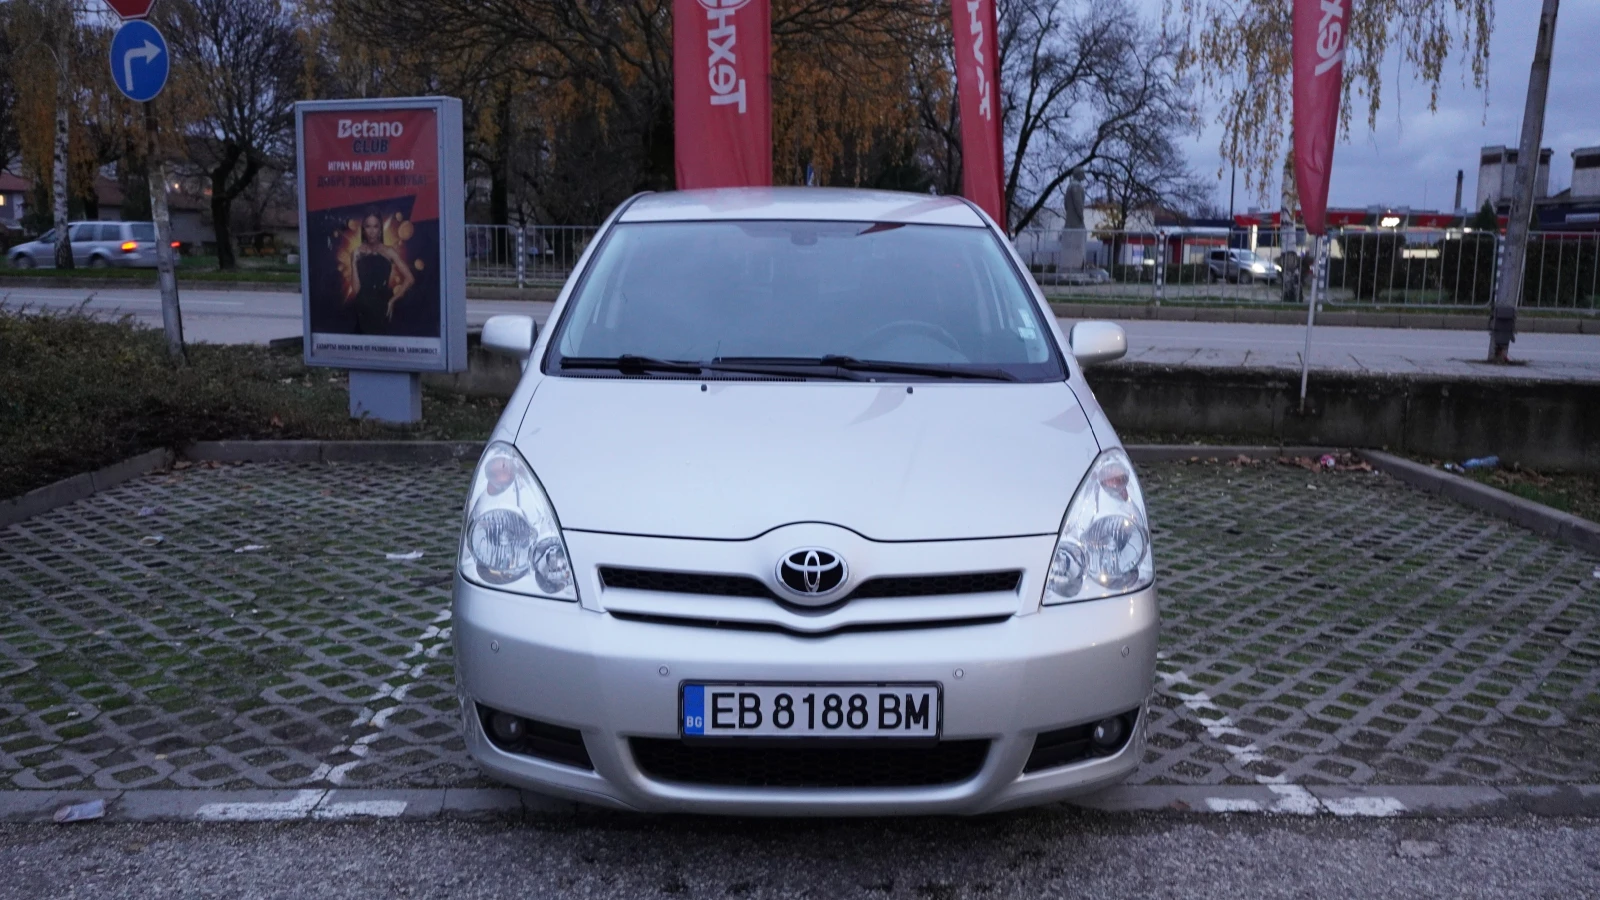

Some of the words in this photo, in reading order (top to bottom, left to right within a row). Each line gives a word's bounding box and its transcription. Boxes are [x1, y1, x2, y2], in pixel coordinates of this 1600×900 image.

[337, 119, 403, 138] Betano
[353, 138, 389, 154] CLUB
[328, 161, 350, 172] ИГРАЧ
[352, 161, 362, 171] НА
[364, 160, 387, 172] ДРУГО
[389, 159, 415, 171] НИВО?
[711, 692, 763, 729] EB
[772, 693, 869, 729] 8188
[878, 693, 930, 730] BM
[686, 716, 703, 728] BG
